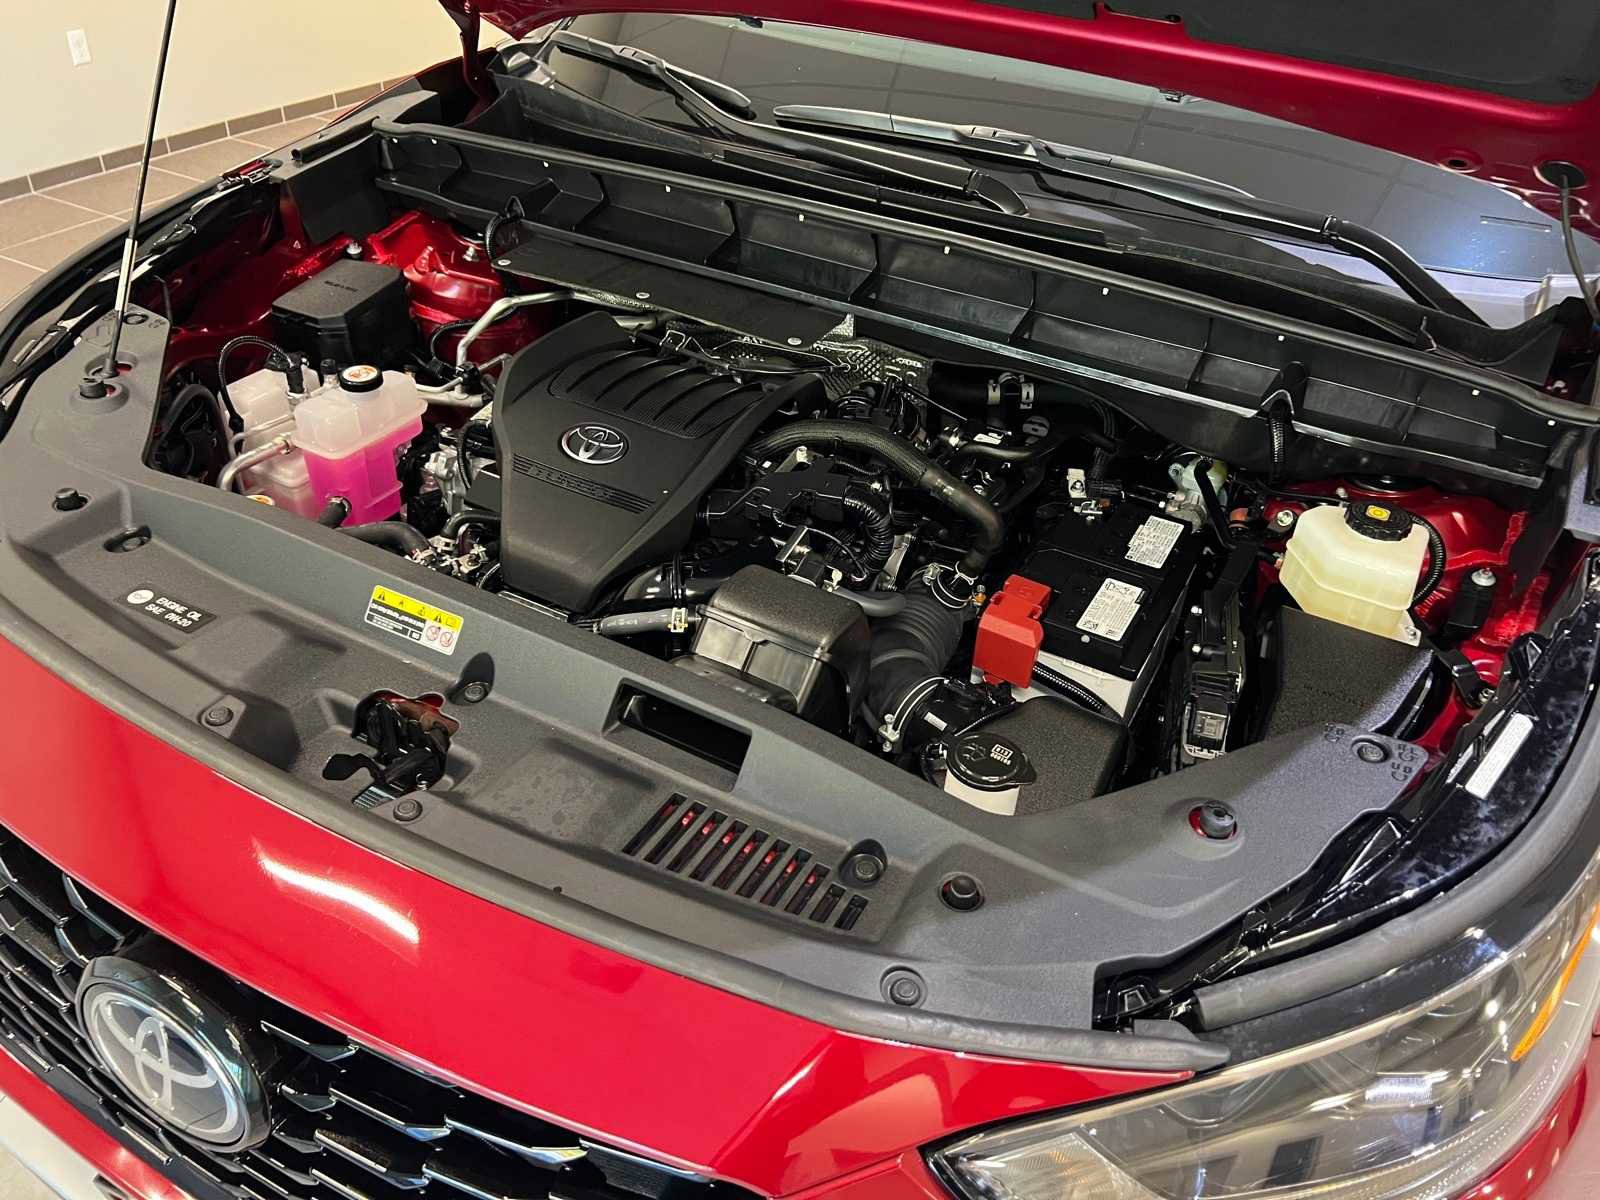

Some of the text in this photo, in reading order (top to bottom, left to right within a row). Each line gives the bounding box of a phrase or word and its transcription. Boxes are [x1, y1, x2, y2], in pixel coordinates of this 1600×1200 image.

[145, 603, 193, 627] SAE 0W-20
[156, 597, 202, 621] ENGINE OIL
